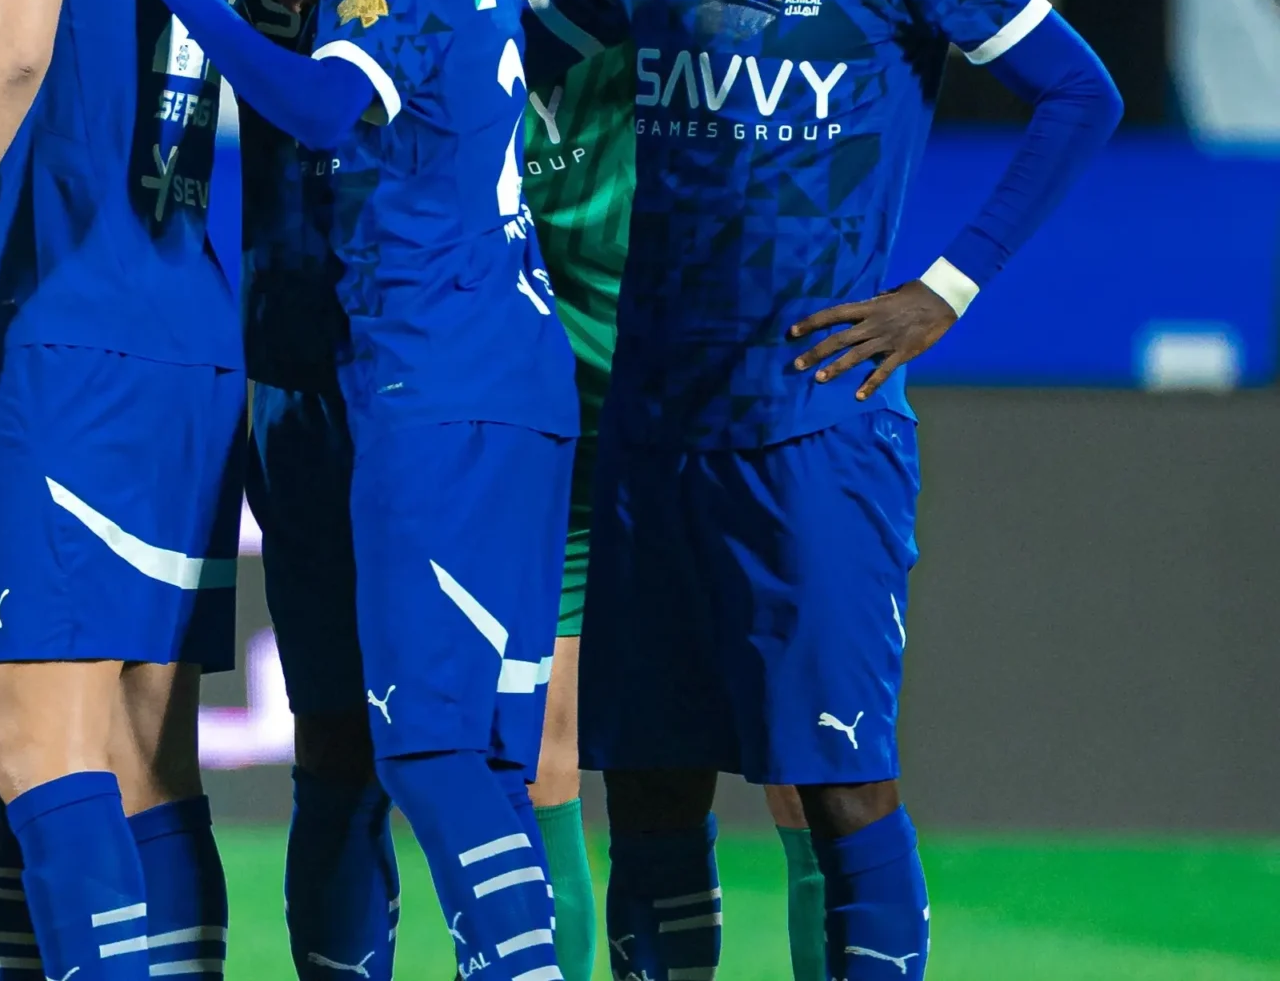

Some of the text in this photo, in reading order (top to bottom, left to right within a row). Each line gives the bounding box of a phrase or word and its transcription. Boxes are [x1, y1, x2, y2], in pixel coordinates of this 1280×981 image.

[635, 47, 848, 120] SAVVY
[635, 119, 842, 142] GAMES GROUP
[527, 147, 586, 175] OUP
[172, 174, 209, 209] SEV
